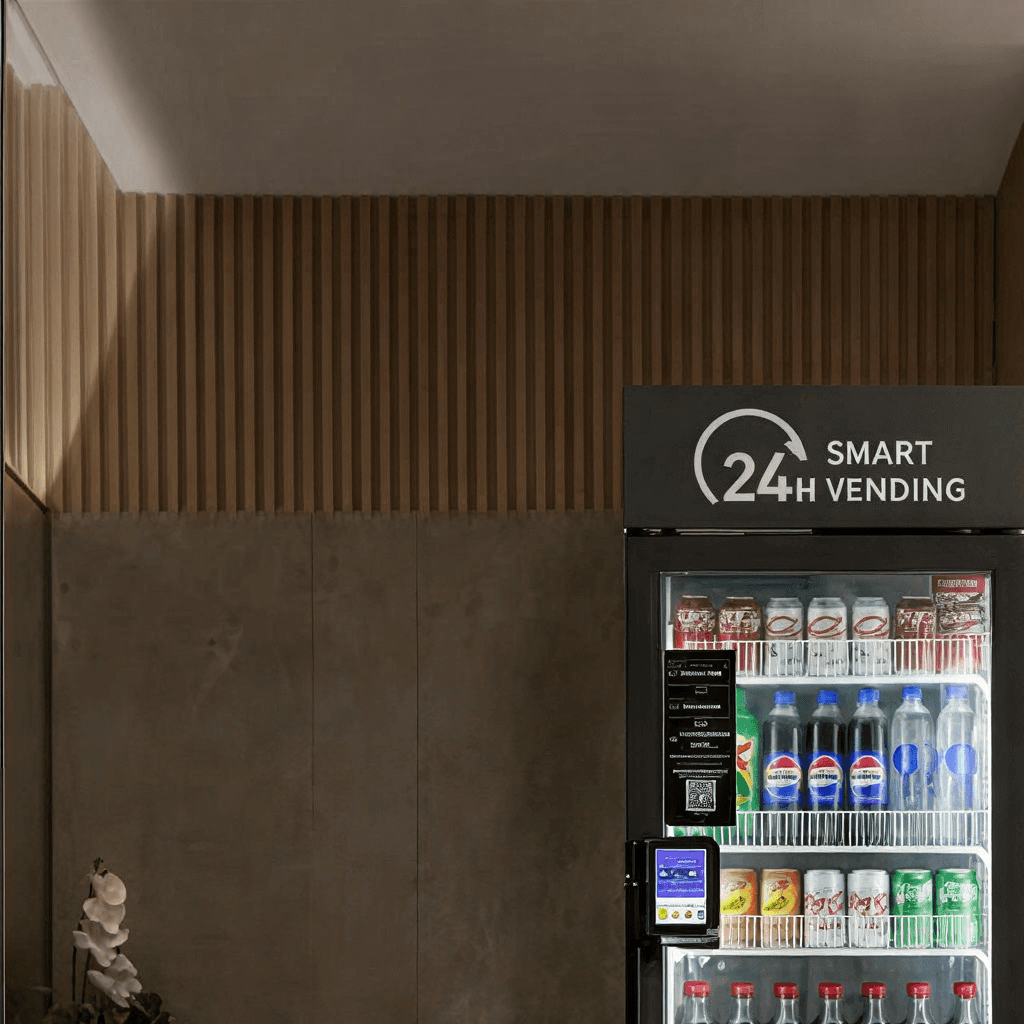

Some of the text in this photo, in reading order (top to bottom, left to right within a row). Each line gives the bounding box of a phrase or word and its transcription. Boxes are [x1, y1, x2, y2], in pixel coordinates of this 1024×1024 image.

[828, 441, 933, 466] SMART
[723, 452, 816, 502] 24H
[826, 478, 966, 502] VENDING
